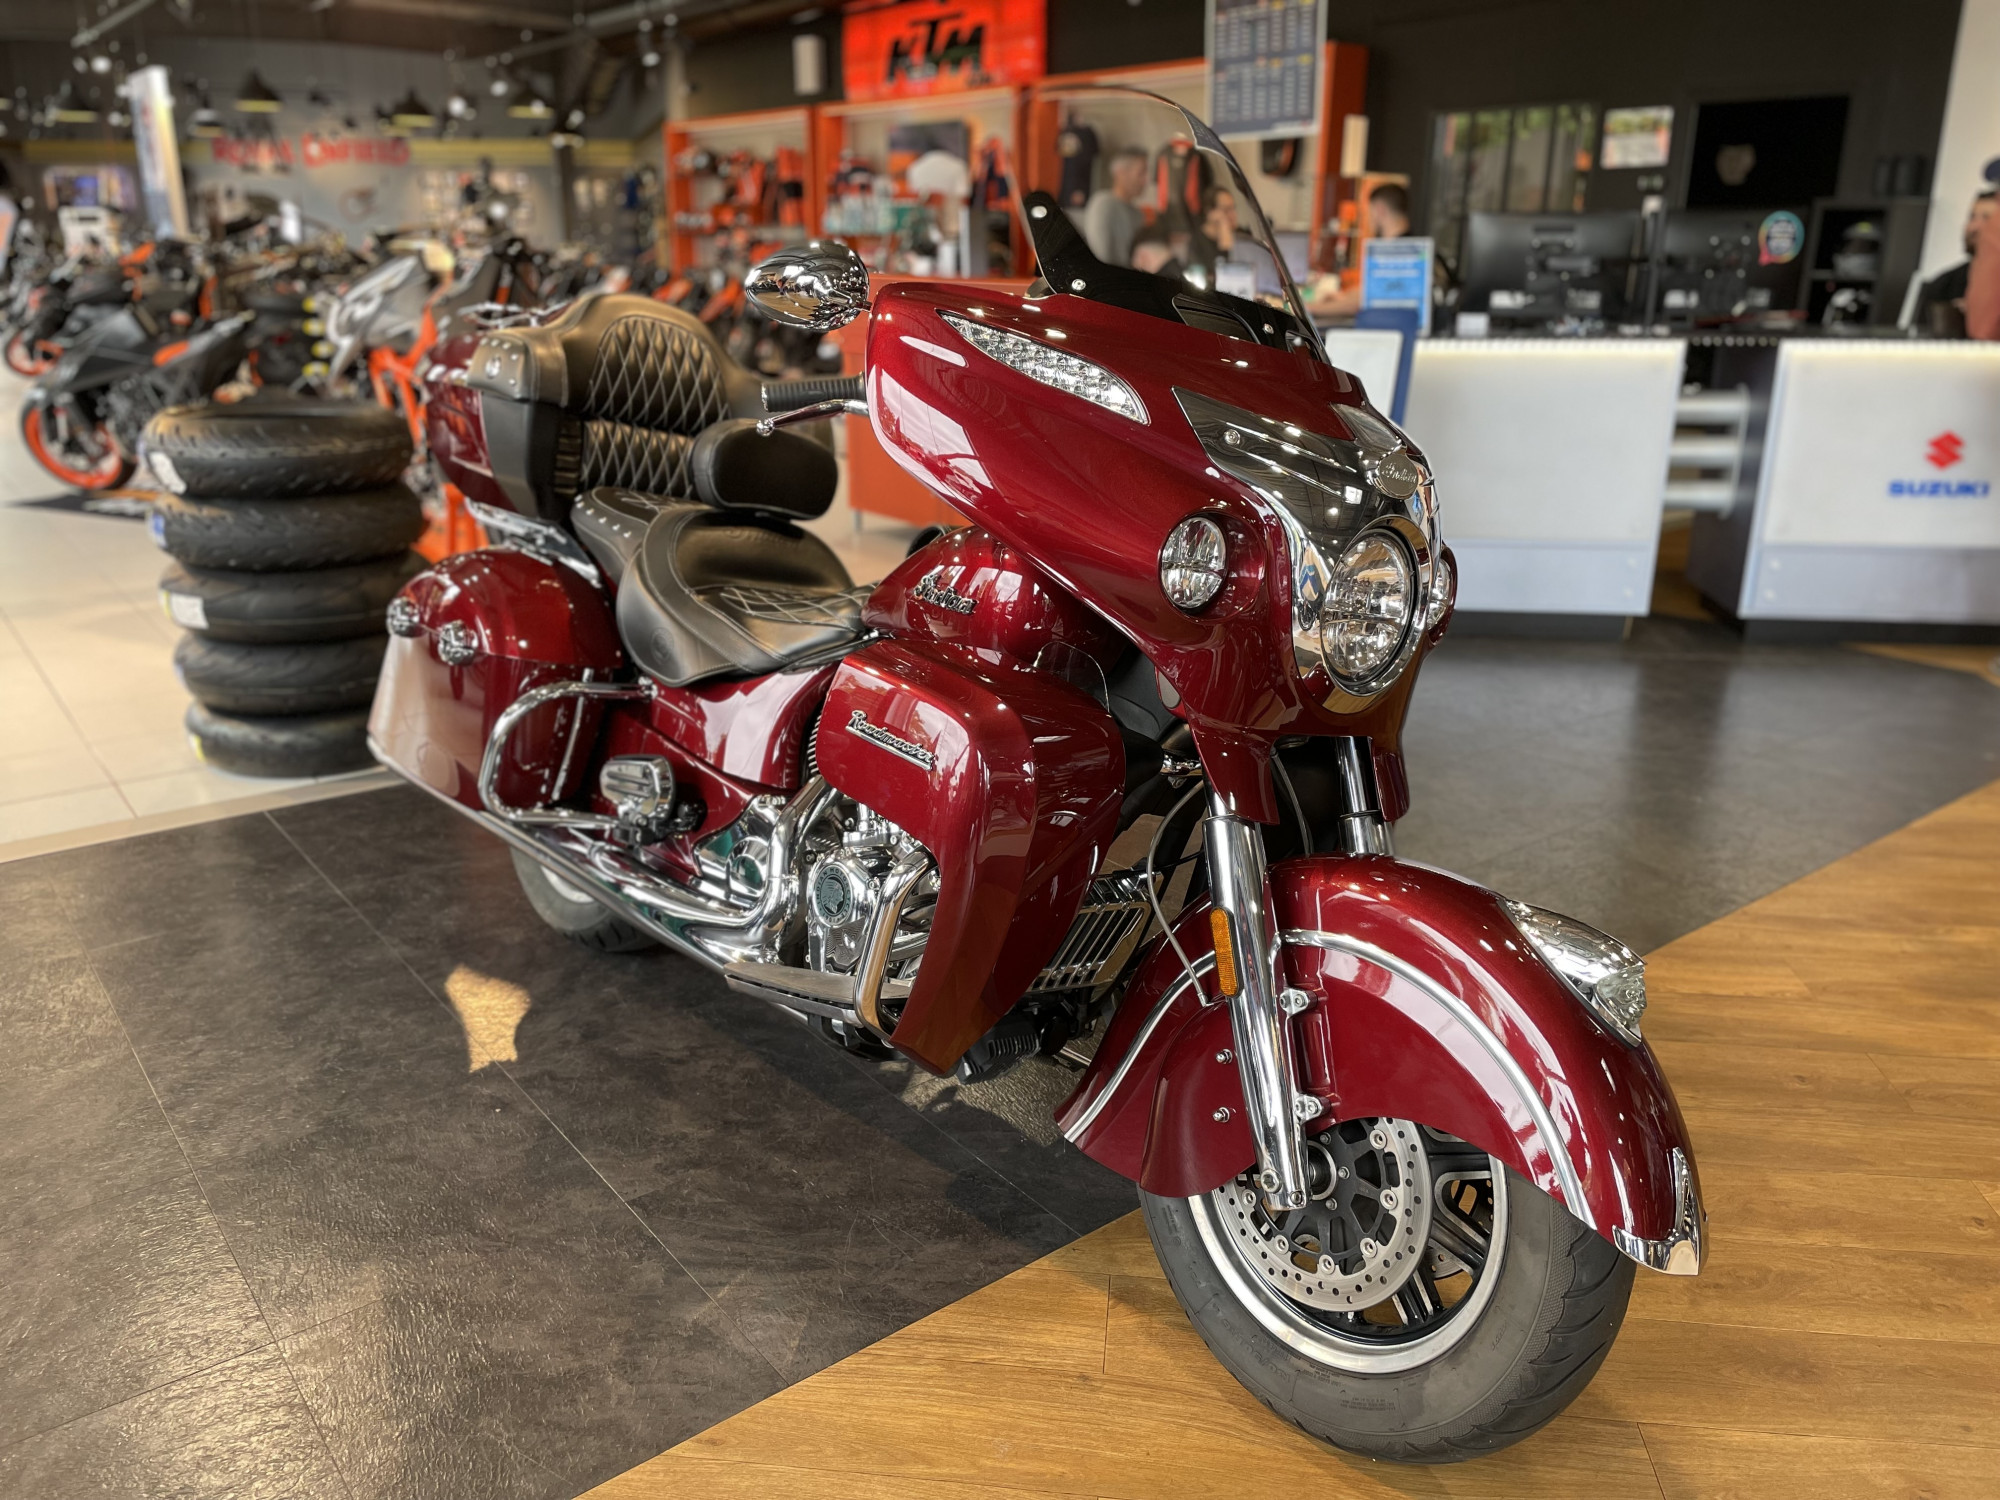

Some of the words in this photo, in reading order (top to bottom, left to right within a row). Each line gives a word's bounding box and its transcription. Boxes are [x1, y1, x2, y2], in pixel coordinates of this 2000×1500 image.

[886, 12, 984, 83] KTM
[1888, 480, 1989, 498] SUZUKI
[914, 574, 977, 614] Indian
[846, 710, 934, 764] Roadmaster
